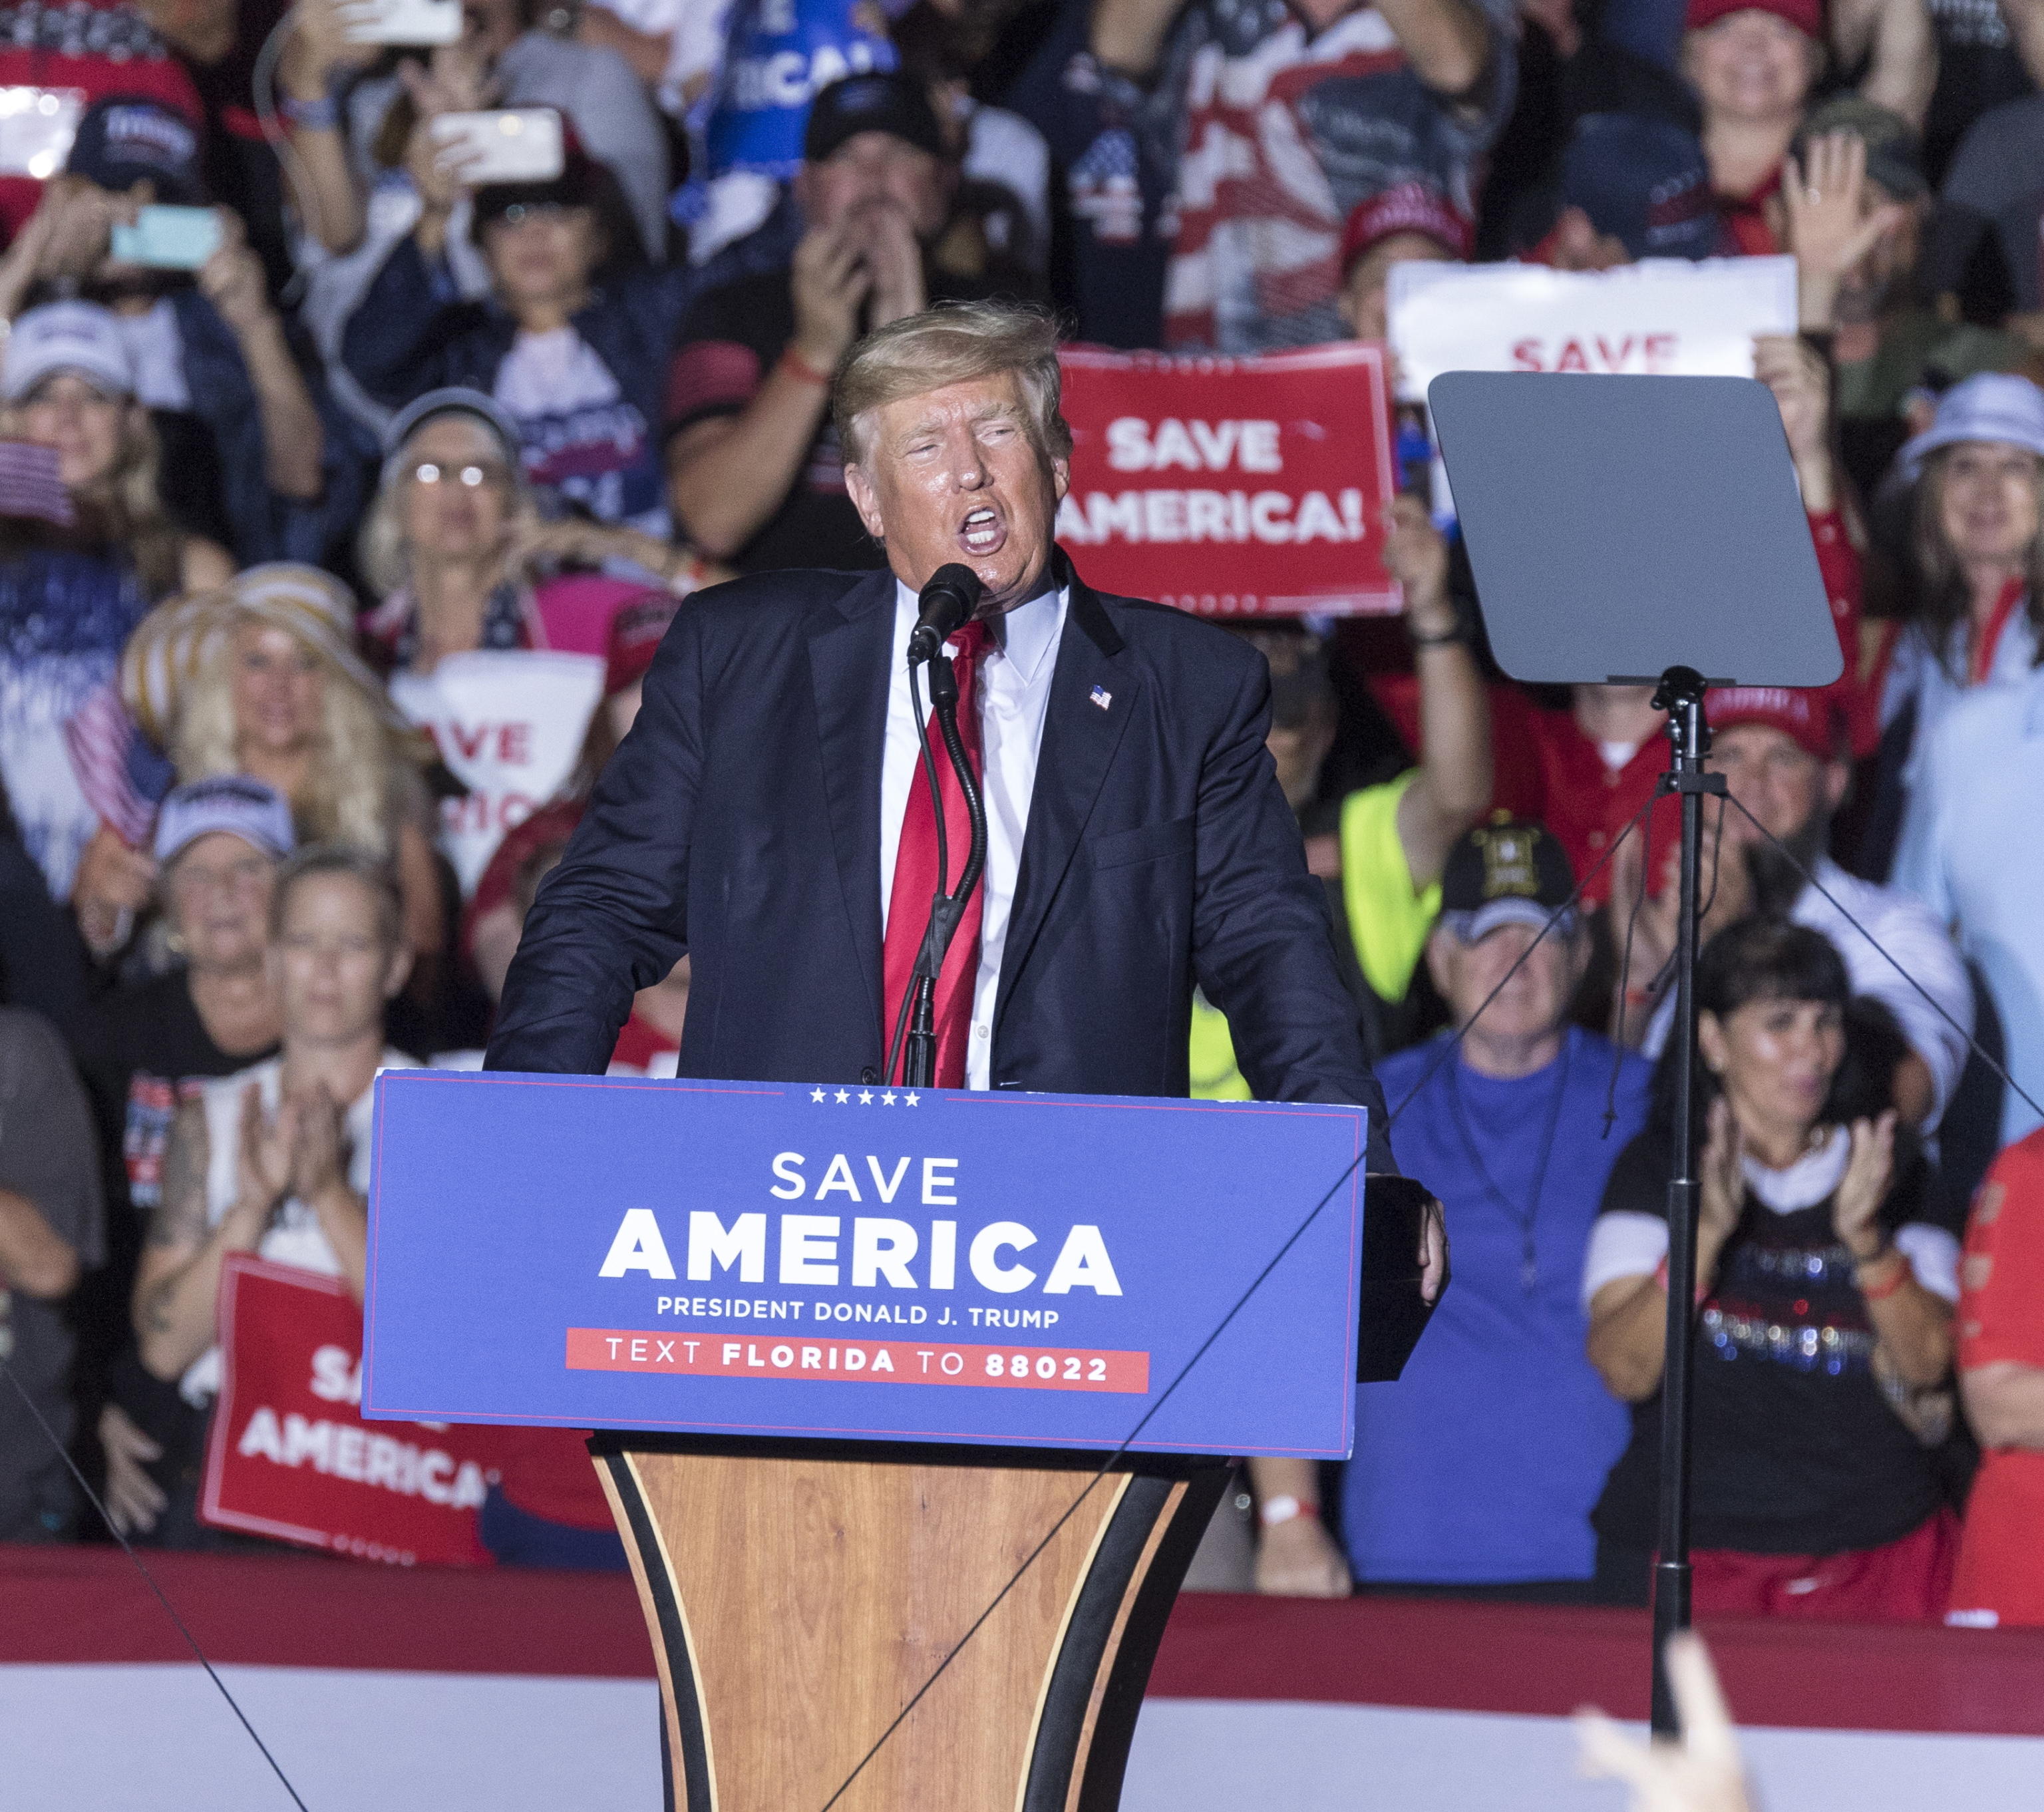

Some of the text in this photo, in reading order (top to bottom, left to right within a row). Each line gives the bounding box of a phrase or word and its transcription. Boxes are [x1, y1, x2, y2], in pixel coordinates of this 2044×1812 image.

[1107, 417, 1282, 472] SAVE
[1055, 488, 1364, 544] AMERICA!
[769, 1151, 959, 1206] SAVE
[597, 1208, 1123, 1296] AMERICA
[657, 1296, 1059, 1329] PRESIDENT DONALD J. TRUMP
[605, 1338, 1107, 1381] TEXT FLORIDA TO 88022
